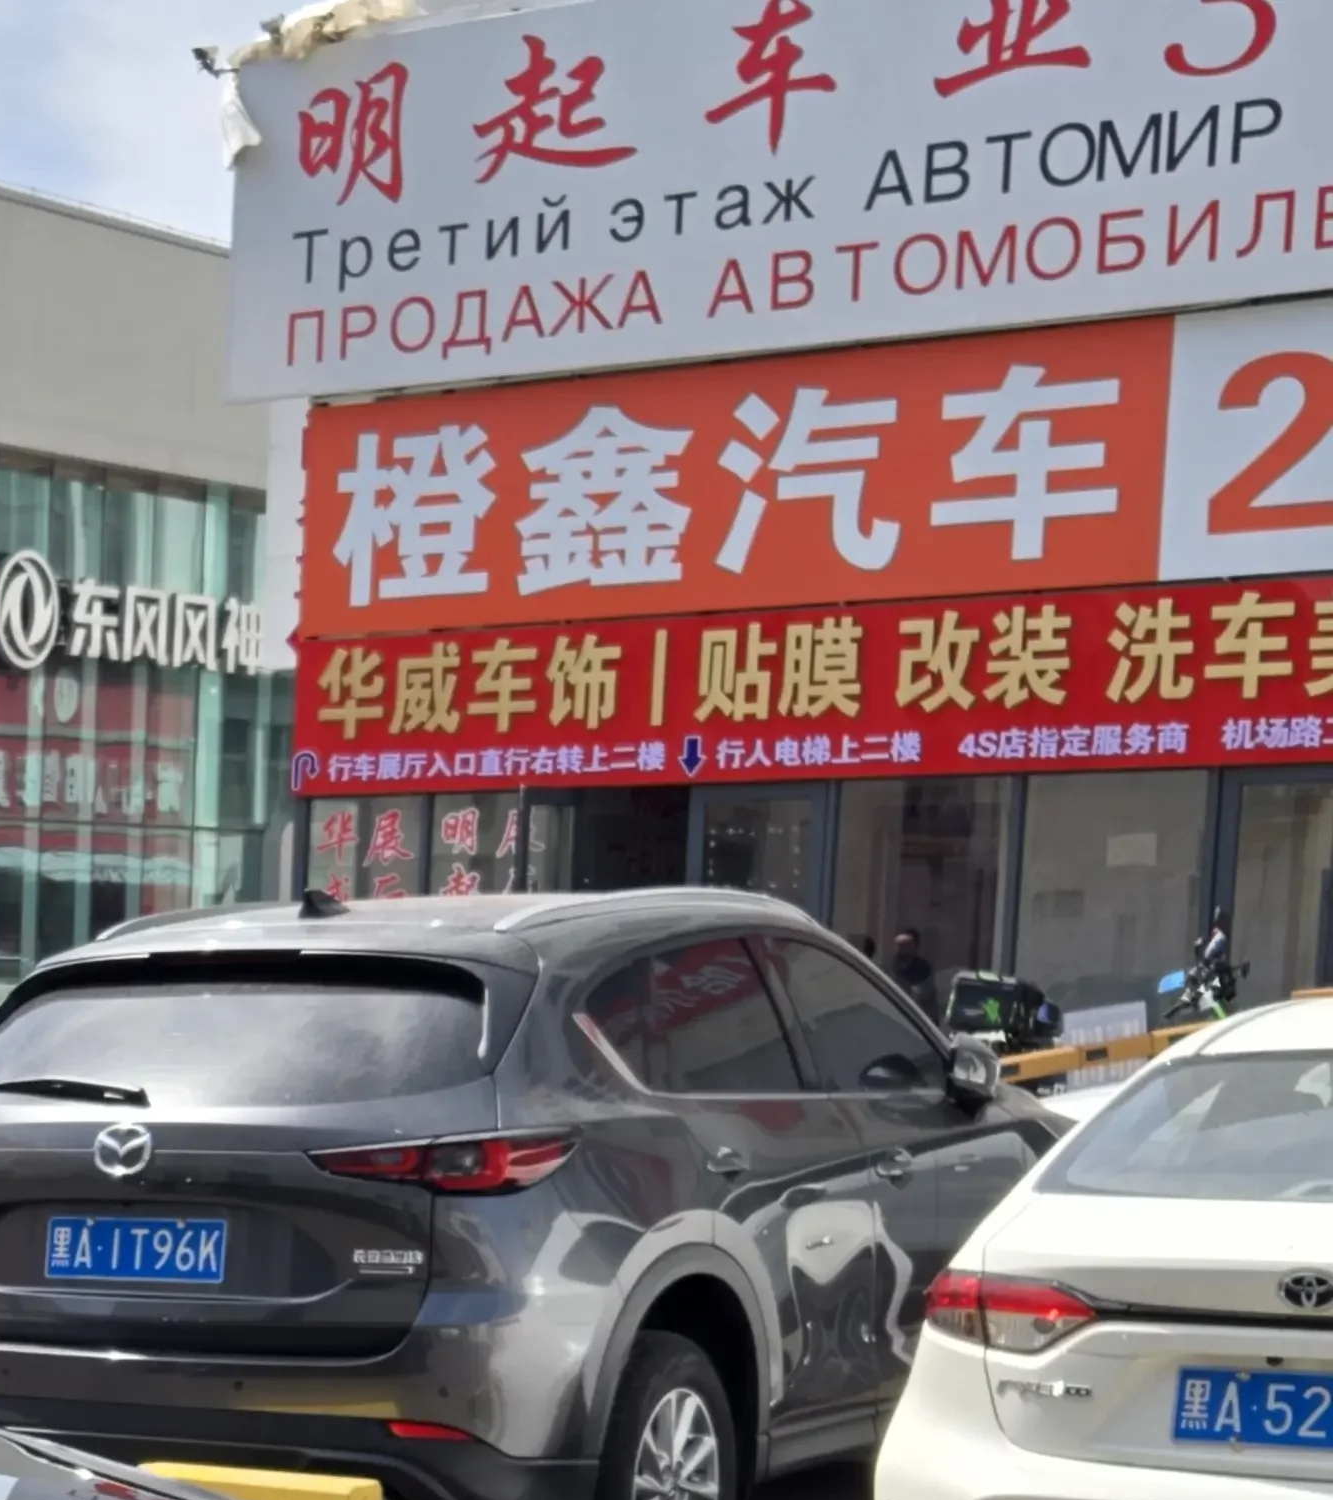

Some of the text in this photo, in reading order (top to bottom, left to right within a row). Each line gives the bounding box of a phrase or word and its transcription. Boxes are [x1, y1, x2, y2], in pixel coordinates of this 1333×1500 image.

[292, 97, 1283, 292] Третий этаж АВТОМИР
[286, 185, 1333, 366] ПРОДАЖА АВТОМОБИЛ
[331, 362, 1121, 606] 橙鑫汽车
[69, 577, 264, 676] 东风风神
[316, 634, 624, 741] 华威车饰
[694, 621, 863, 722] 贴膜
[894, 604, 1072, 713] 改装
[328, 740, 666, 783] 行车展厅入口直行右转上二楼
[716, 730, 922, 769] 行人电梯上二楼
[957, 722, 1190, 759] 4S店指定服务商
